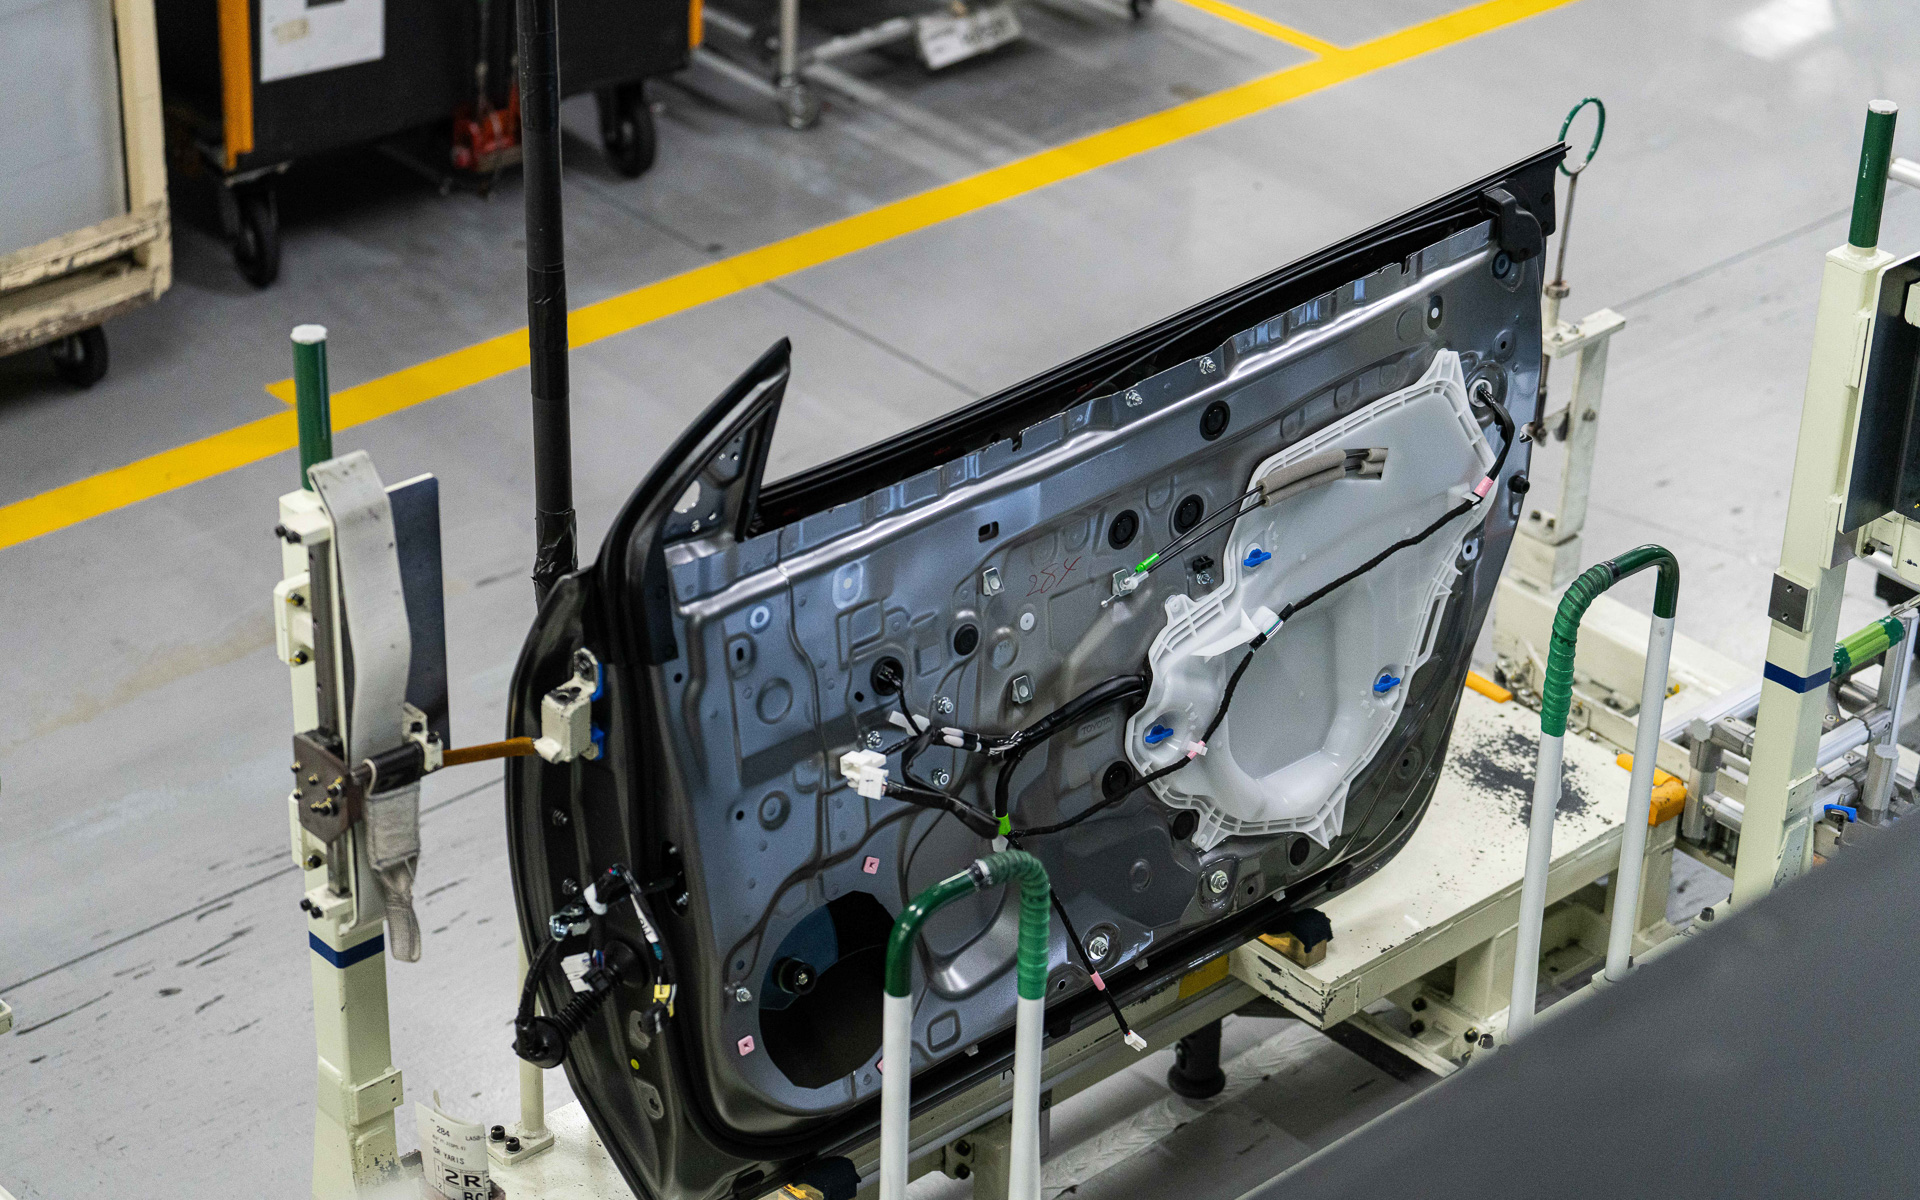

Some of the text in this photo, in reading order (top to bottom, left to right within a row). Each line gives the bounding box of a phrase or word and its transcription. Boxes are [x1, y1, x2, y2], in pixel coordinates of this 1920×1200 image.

[1026, 556, 1082, 597] 284
[1081, 716, 1112, 734] TOYOTA
[443, 1152, 465, 1165] YARIS
